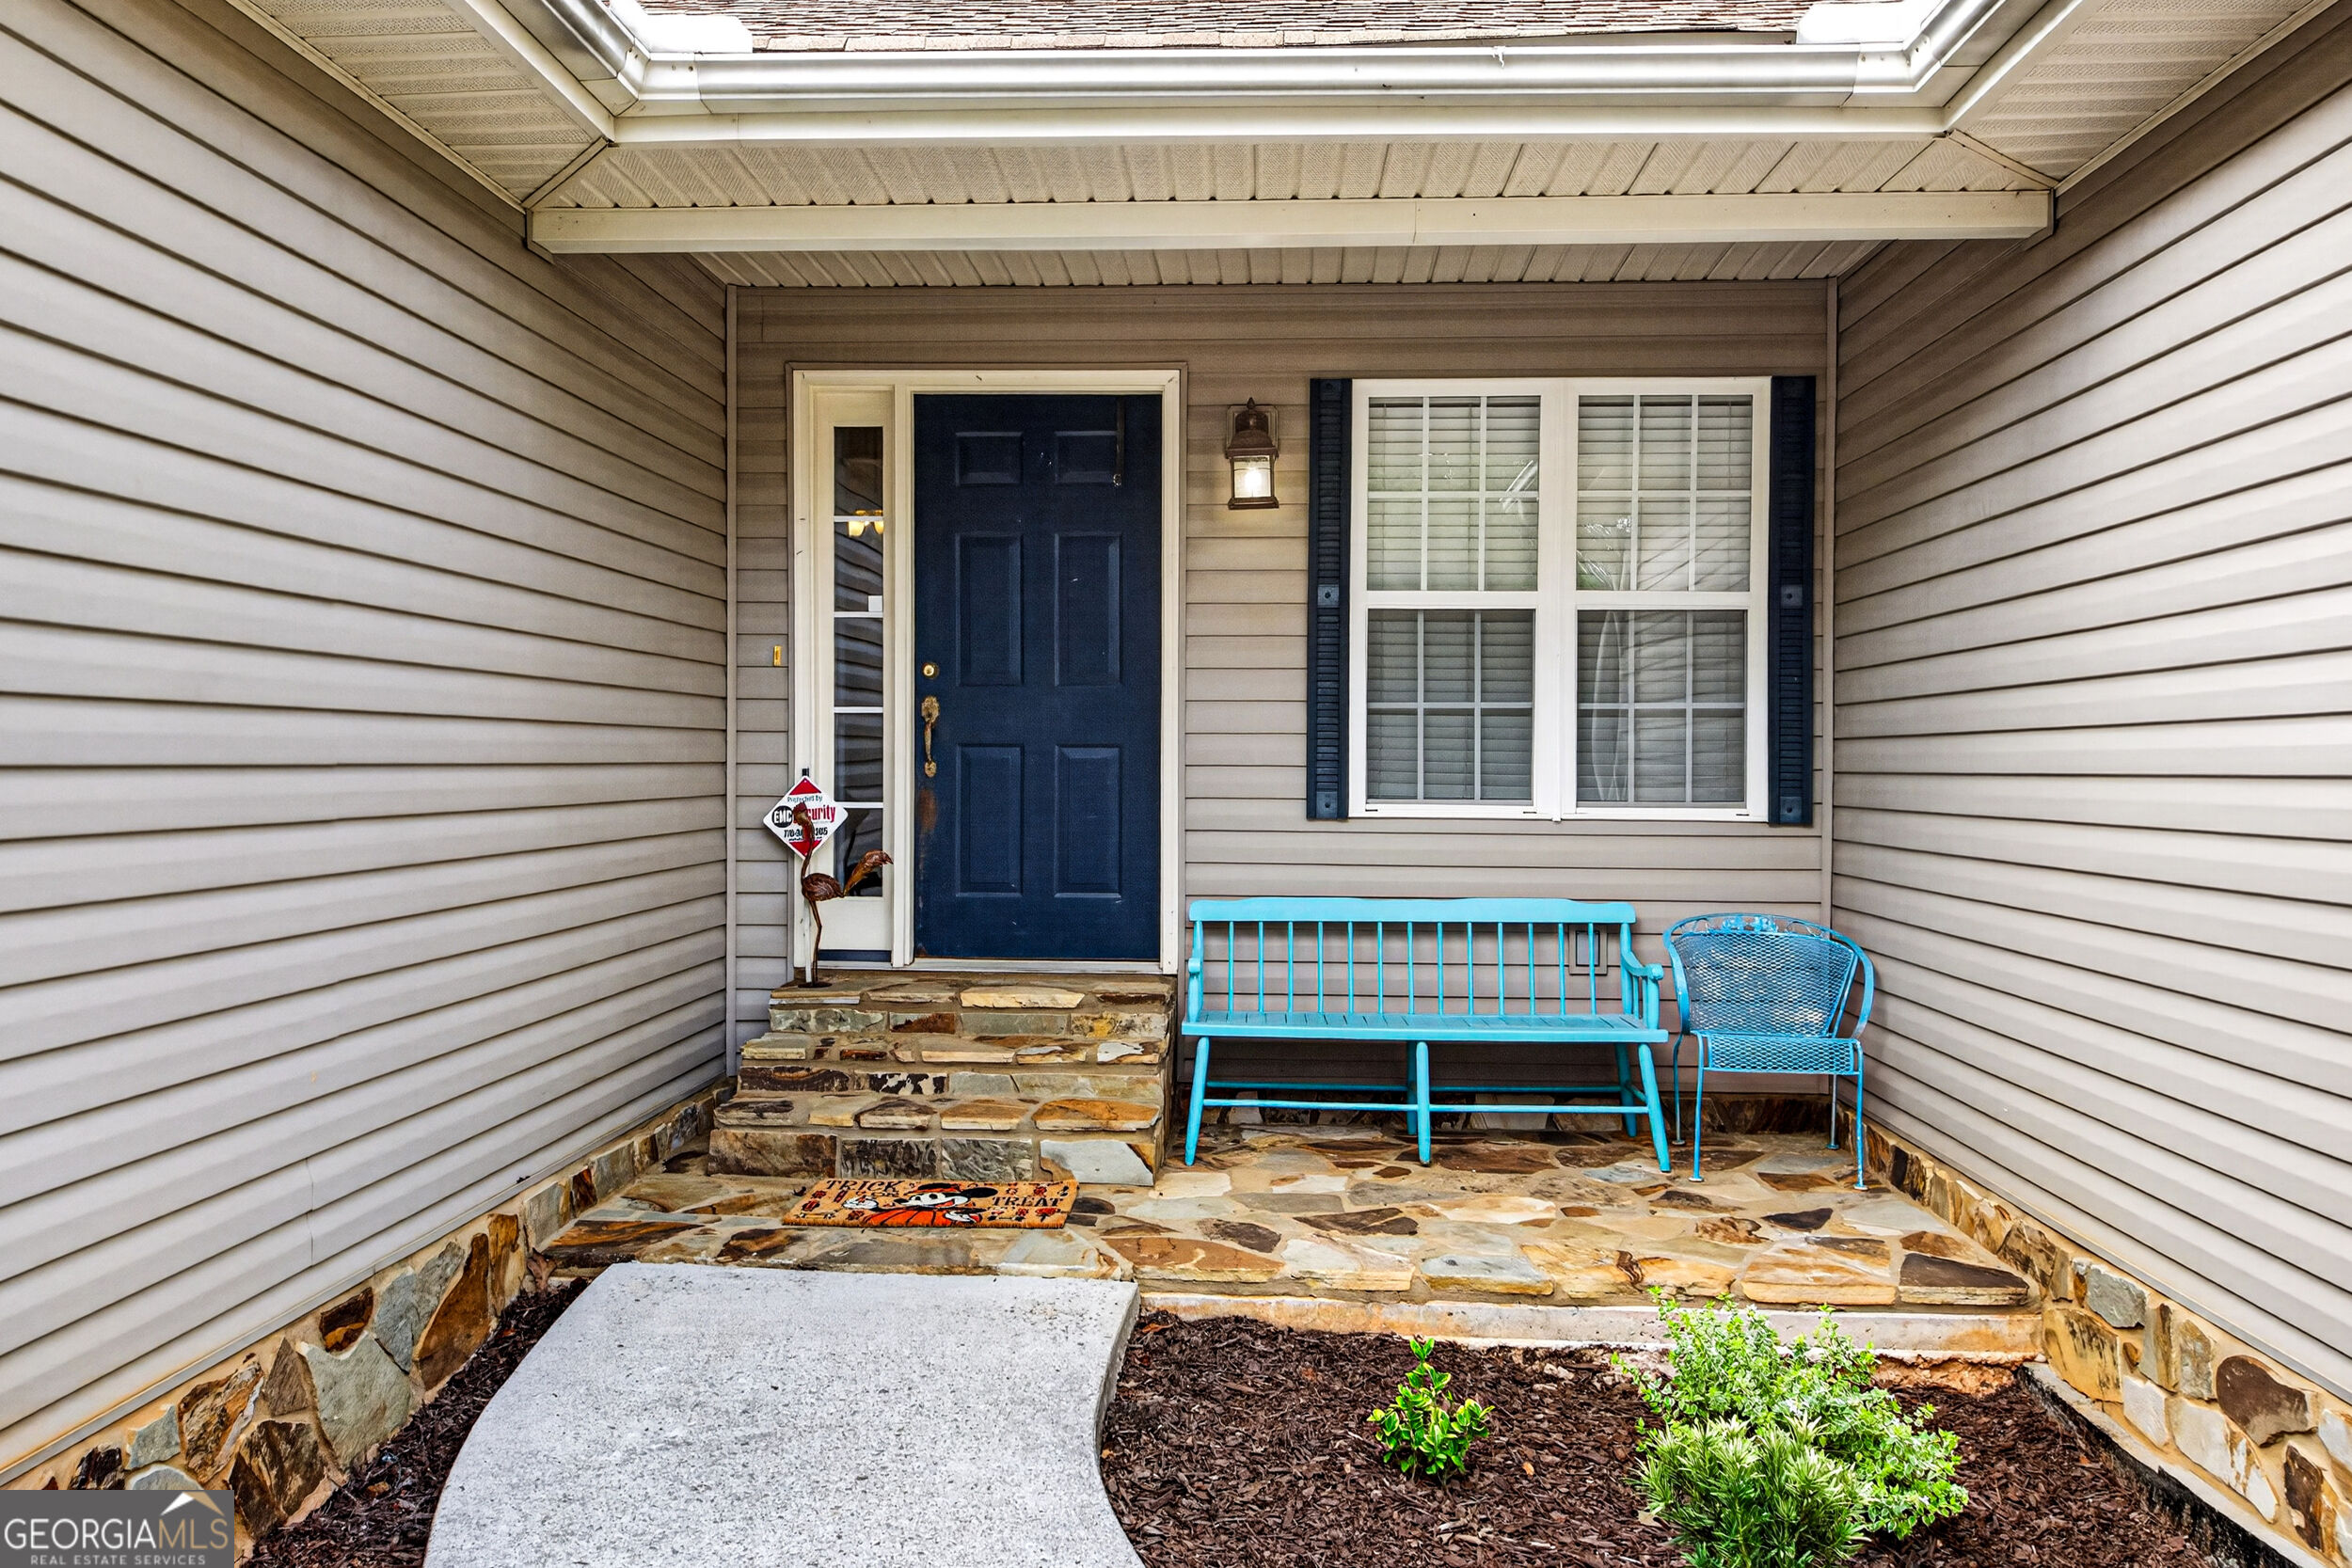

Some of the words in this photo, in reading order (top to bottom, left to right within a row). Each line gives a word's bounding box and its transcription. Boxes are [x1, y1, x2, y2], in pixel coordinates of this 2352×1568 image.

[773, 809, 792, 824] EMC
[826, 1180, 906, 1193] TRICK
[992, 1196, 1064, 1208] TREAT
